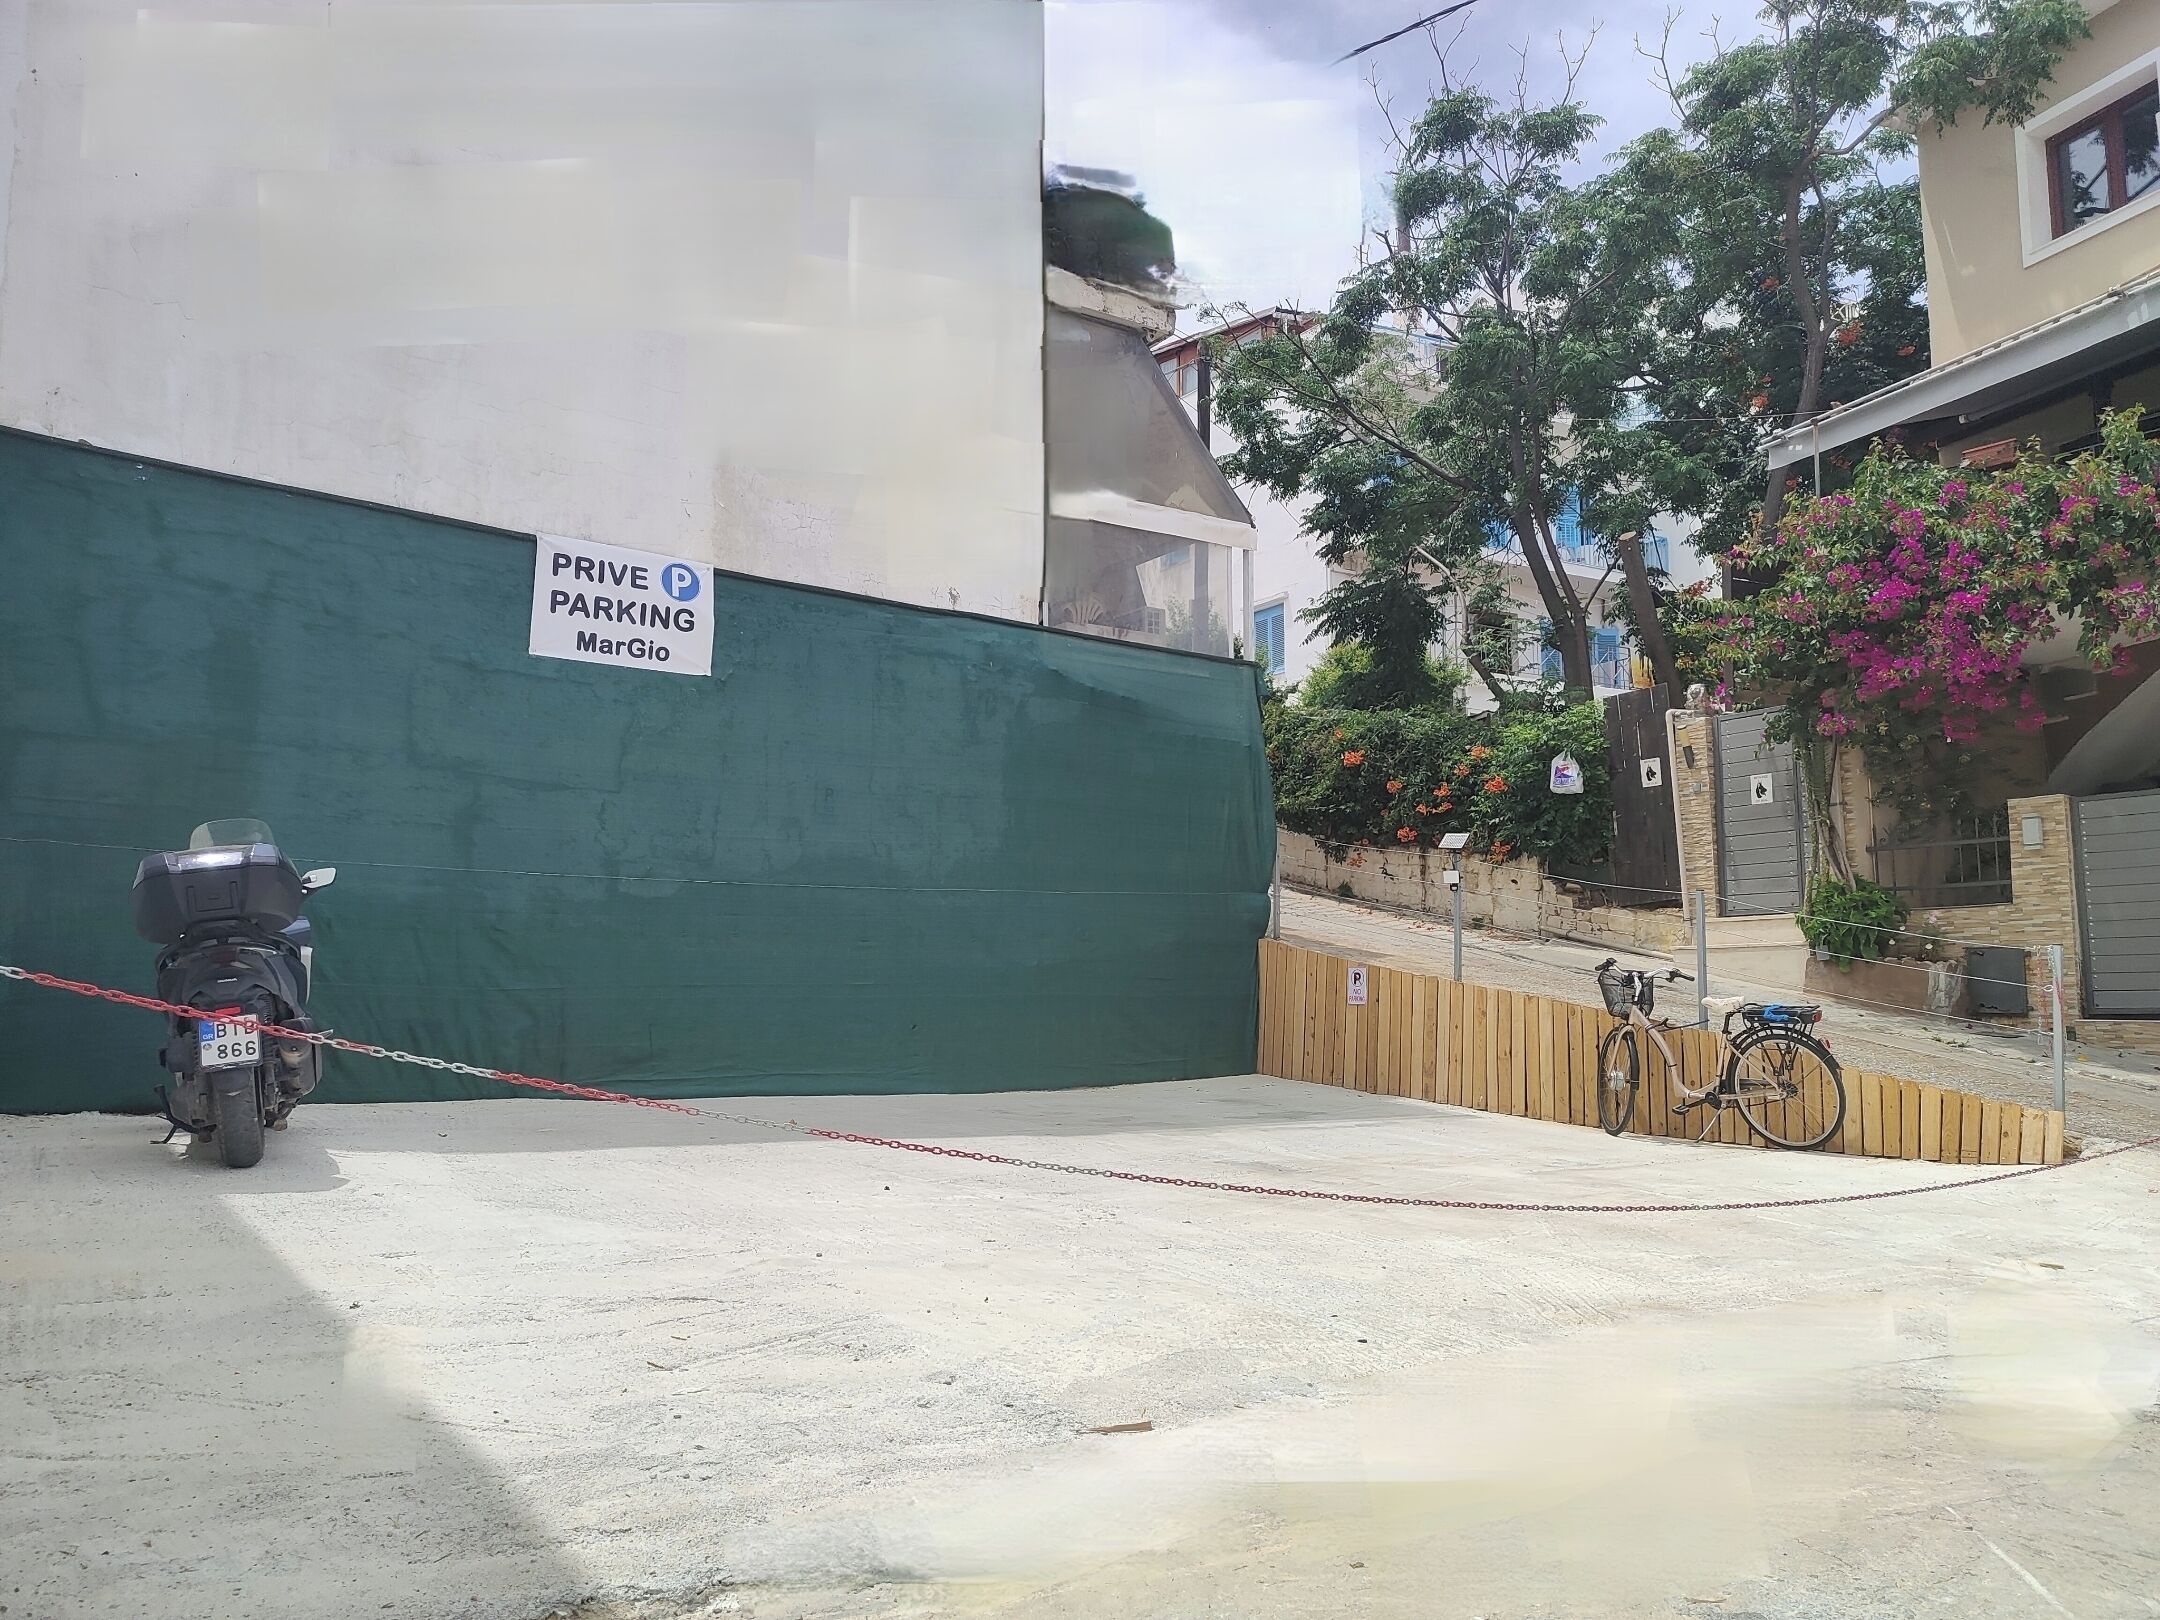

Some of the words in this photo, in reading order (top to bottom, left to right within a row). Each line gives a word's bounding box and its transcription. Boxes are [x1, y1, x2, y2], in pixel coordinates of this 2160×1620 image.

[552, 553, 648, 590] PRIVE
[670, 566, 693, 598] P
[550, 590, 695, 632] PARKING
[576, 631, 670, 661] MarGio
[217, 1040, 257, 1059] 866
